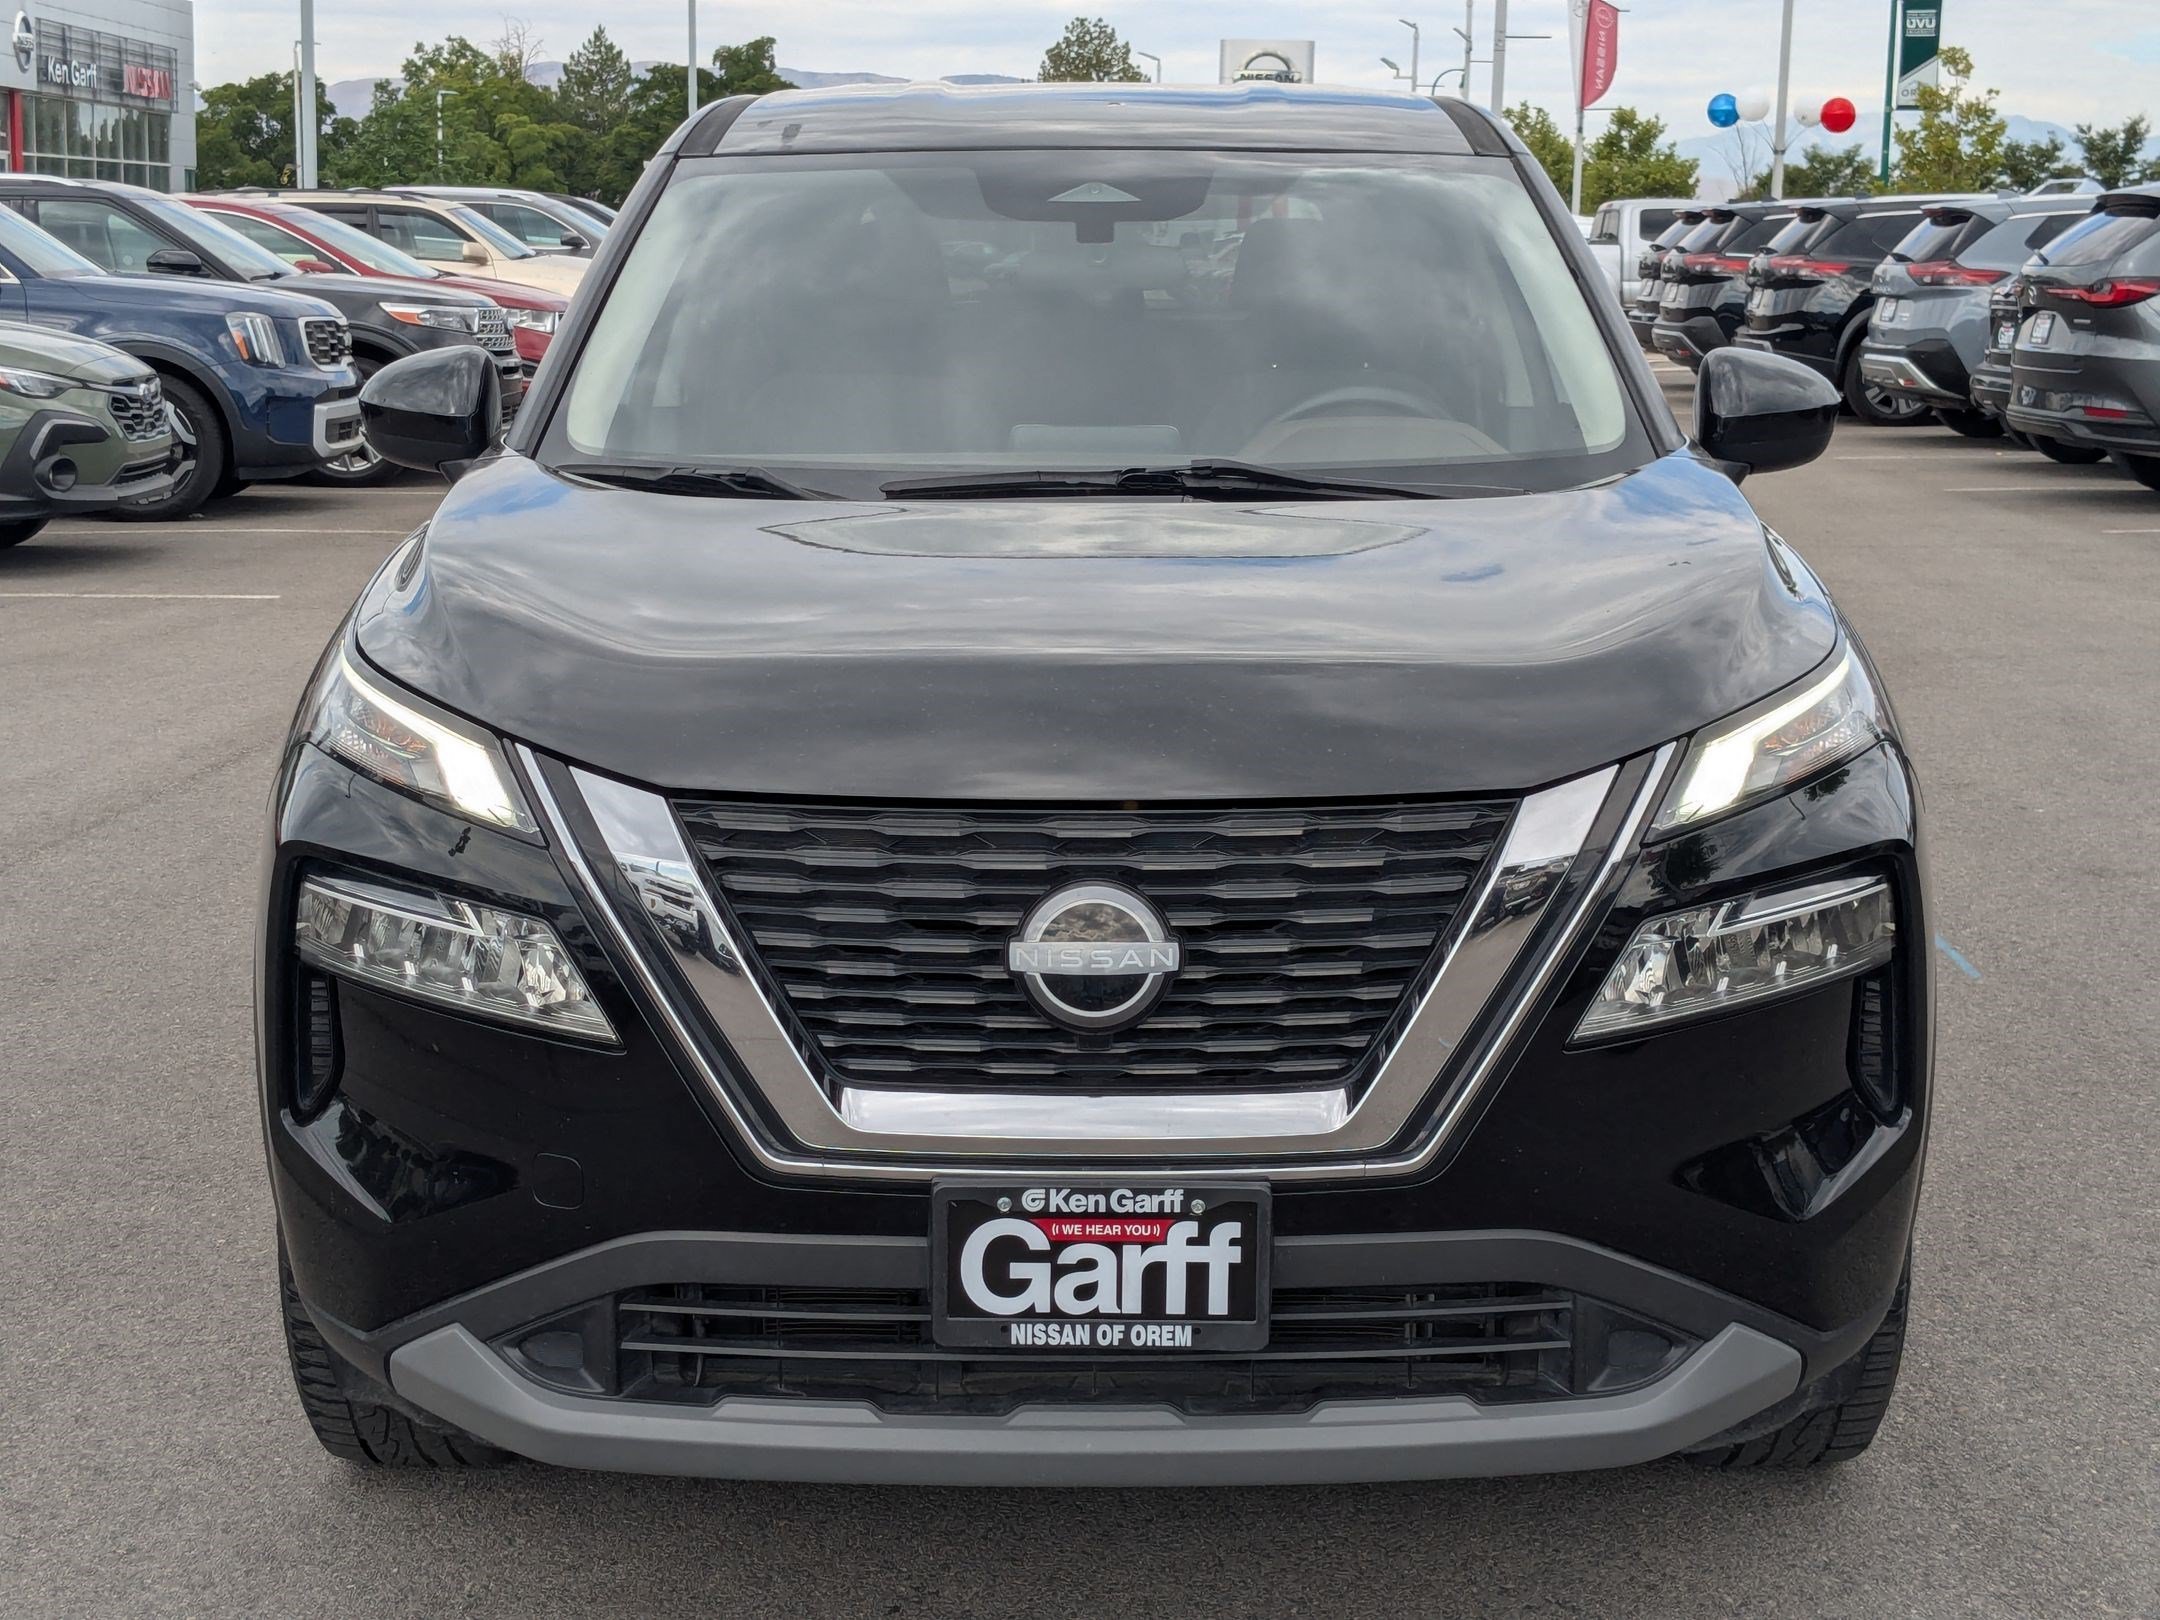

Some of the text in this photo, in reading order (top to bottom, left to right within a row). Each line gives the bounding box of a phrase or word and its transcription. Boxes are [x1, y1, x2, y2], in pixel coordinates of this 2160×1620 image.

[1906, 17, 1936, 29] UVU
[48, 56, 97, 89] Ken Garff
[1016, 947, 1173, 969] NISSAN
[1049, 1188, 1184, 1214] Ken Garff
[1061, 1224, 1151, 1236] WE HEAR YOU
[960, 1217, 1242, 1316] Garff
[1011, 1324, 1192, 1347] NISSAN OF OREM
